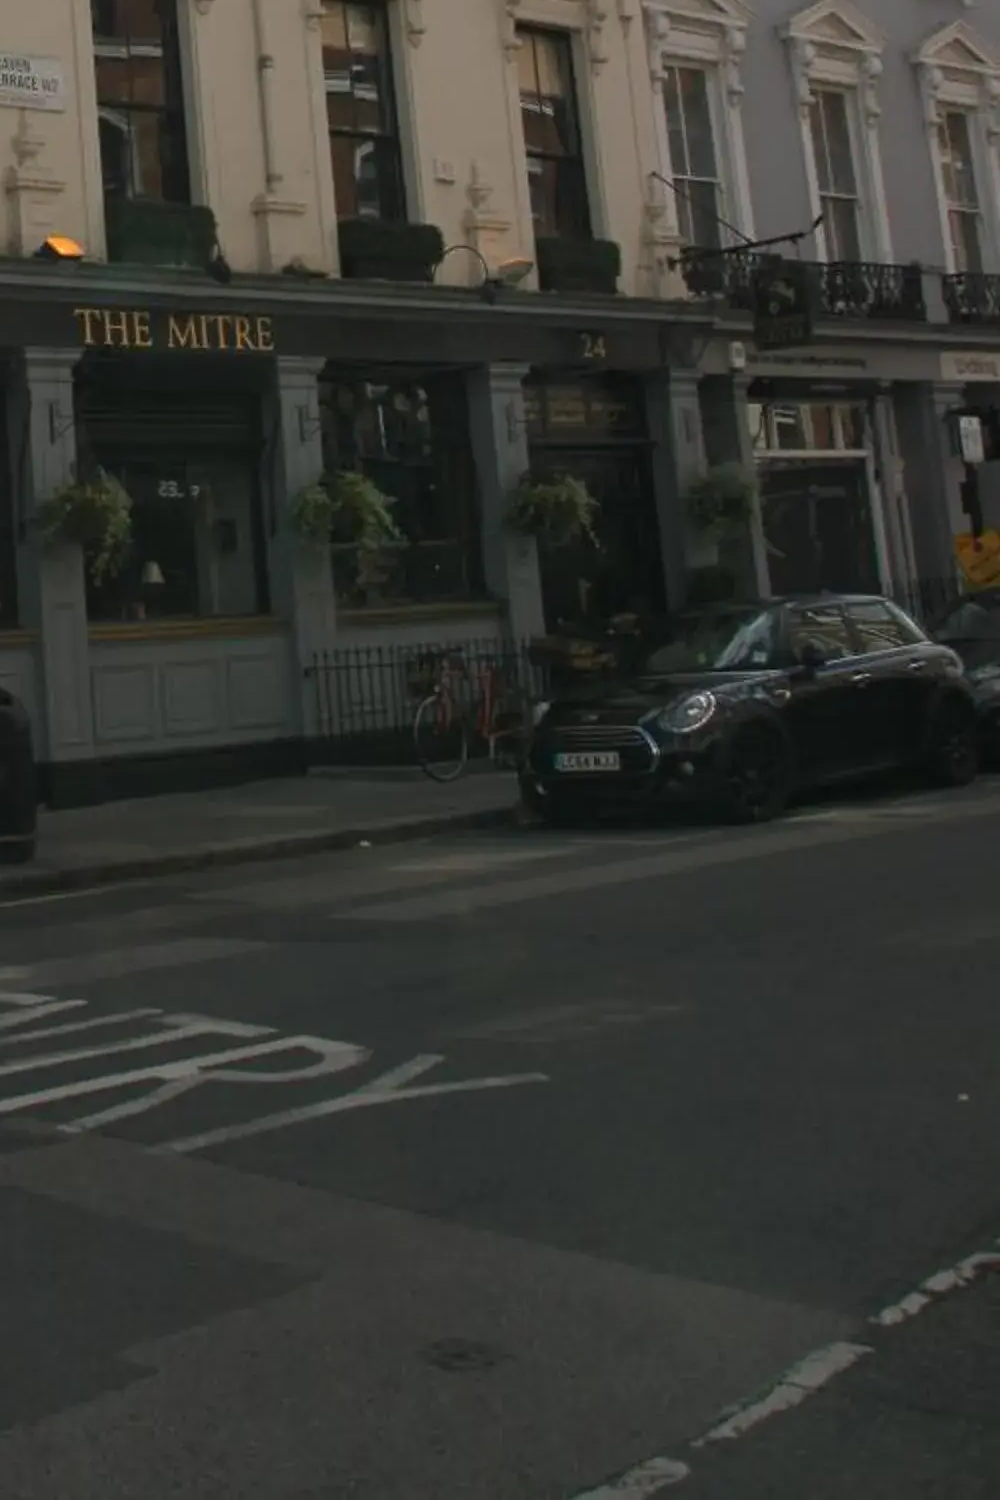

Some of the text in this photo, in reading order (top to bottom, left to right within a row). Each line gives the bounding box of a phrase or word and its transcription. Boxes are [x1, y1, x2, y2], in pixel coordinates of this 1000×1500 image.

[41, 78, 59, 93] W2
[73, 308, 275, 352] THE MITRE
[580, 332, 606, 358] 24
